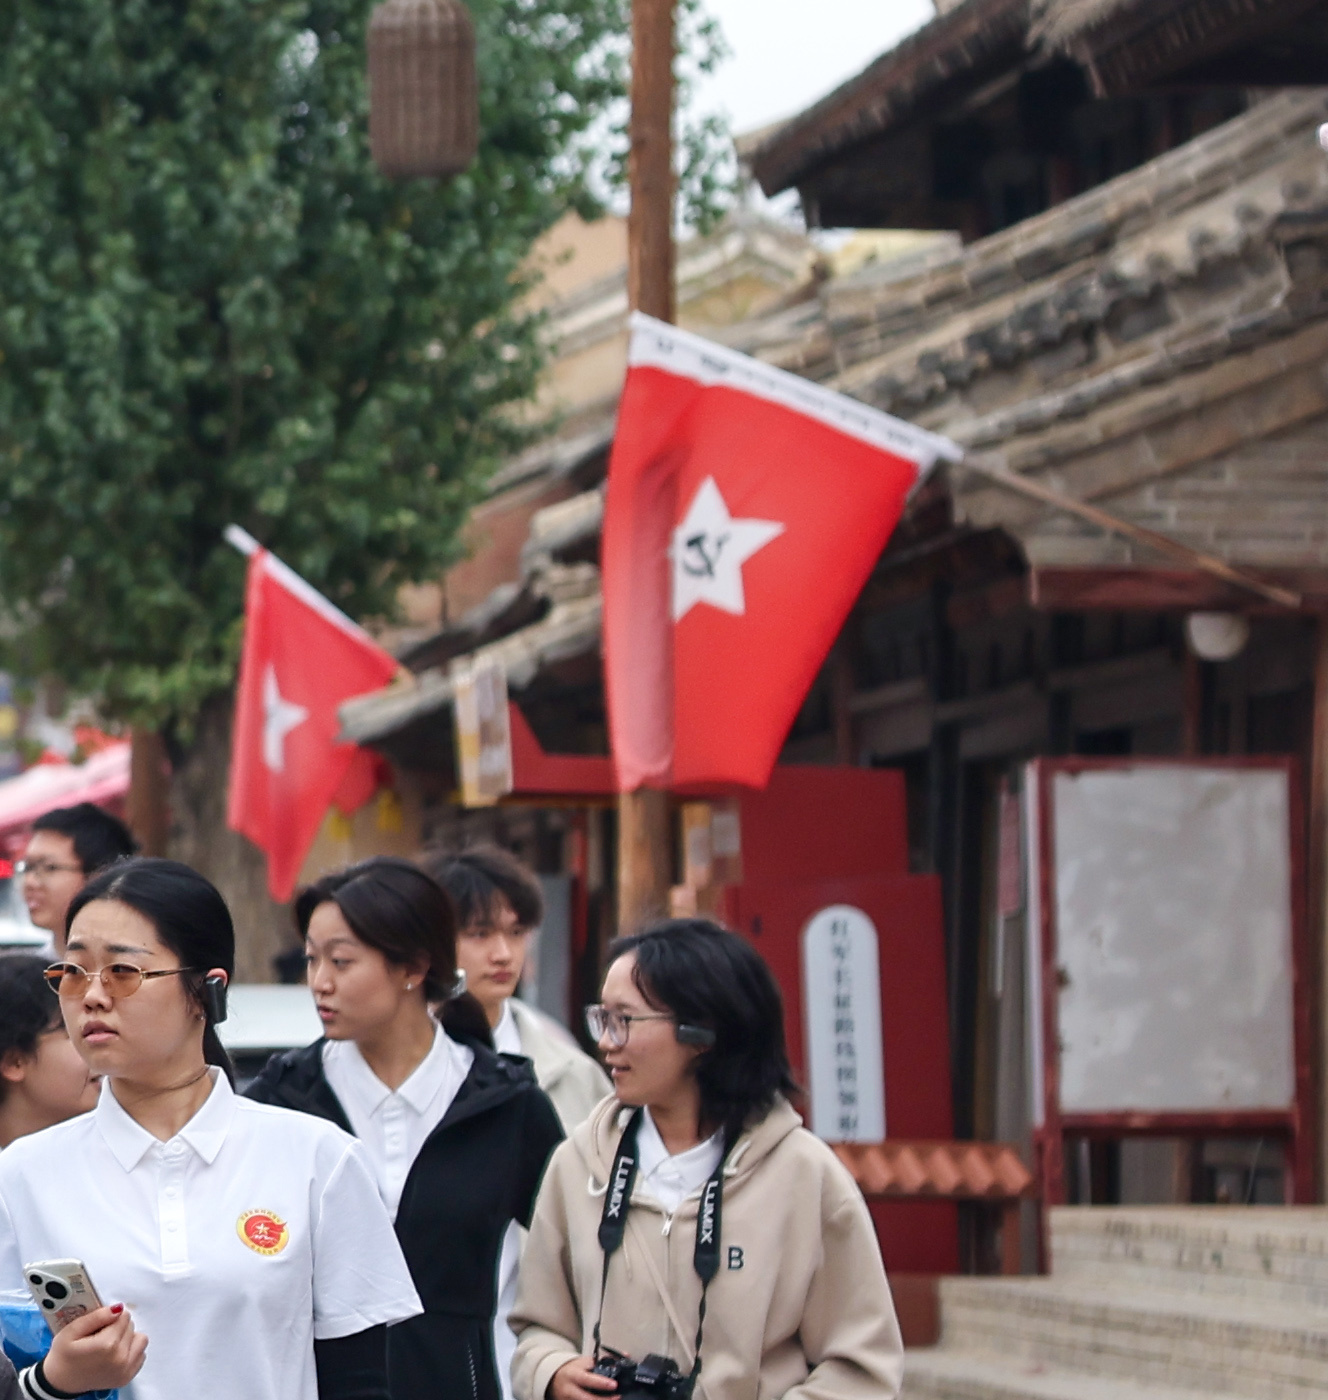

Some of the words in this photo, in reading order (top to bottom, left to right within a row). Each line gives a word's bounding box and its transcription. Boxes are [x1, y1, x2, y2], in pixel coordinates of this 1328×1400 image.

[607, 1156, 635, 1219] LUMIX
[700, 1180, 719, 1245] LUMIX
[727, 1246, 745, 1270] B
